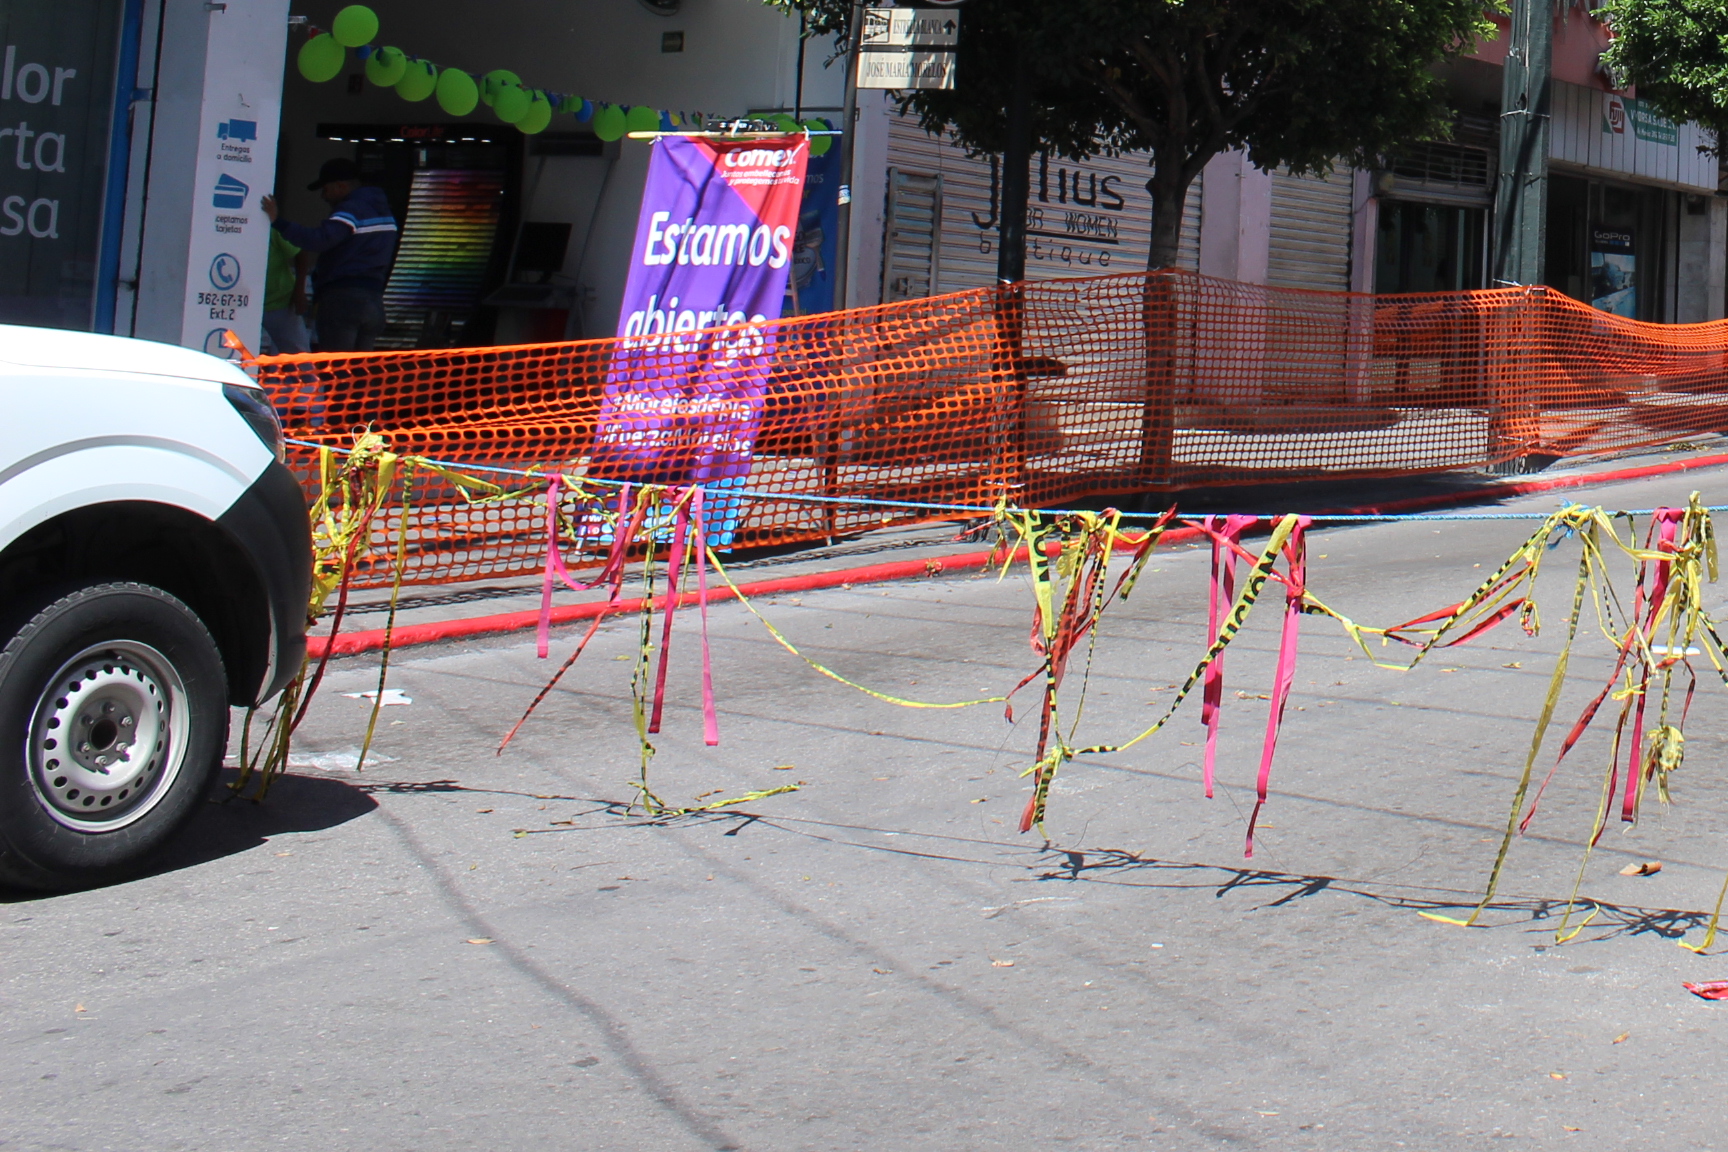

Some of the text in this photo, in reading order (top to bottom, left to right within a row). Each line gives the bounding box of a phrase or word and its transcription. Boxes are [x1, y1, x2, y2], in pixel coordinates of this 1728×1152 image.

[221, 142, 250, 154] Entregas
[223, 152, 253, 163] domicilio
[971, 149, 1125, 230] Jlius
[215, 216, 248, 225] ceptamos
[1065, 212, 1119, 238] WOMEN
[216, 224, 242, 234] tarjetas
[643, 211, 791, 269] Estamos
[1594, 231, 1631, 241] GoPro
[980, 232, 1111, 267] btique
[198, 292, 249, 307] 362-67-30
[209, 308, 235, 320] Ext. 2
[622, 294, 767, 367] abiertos
